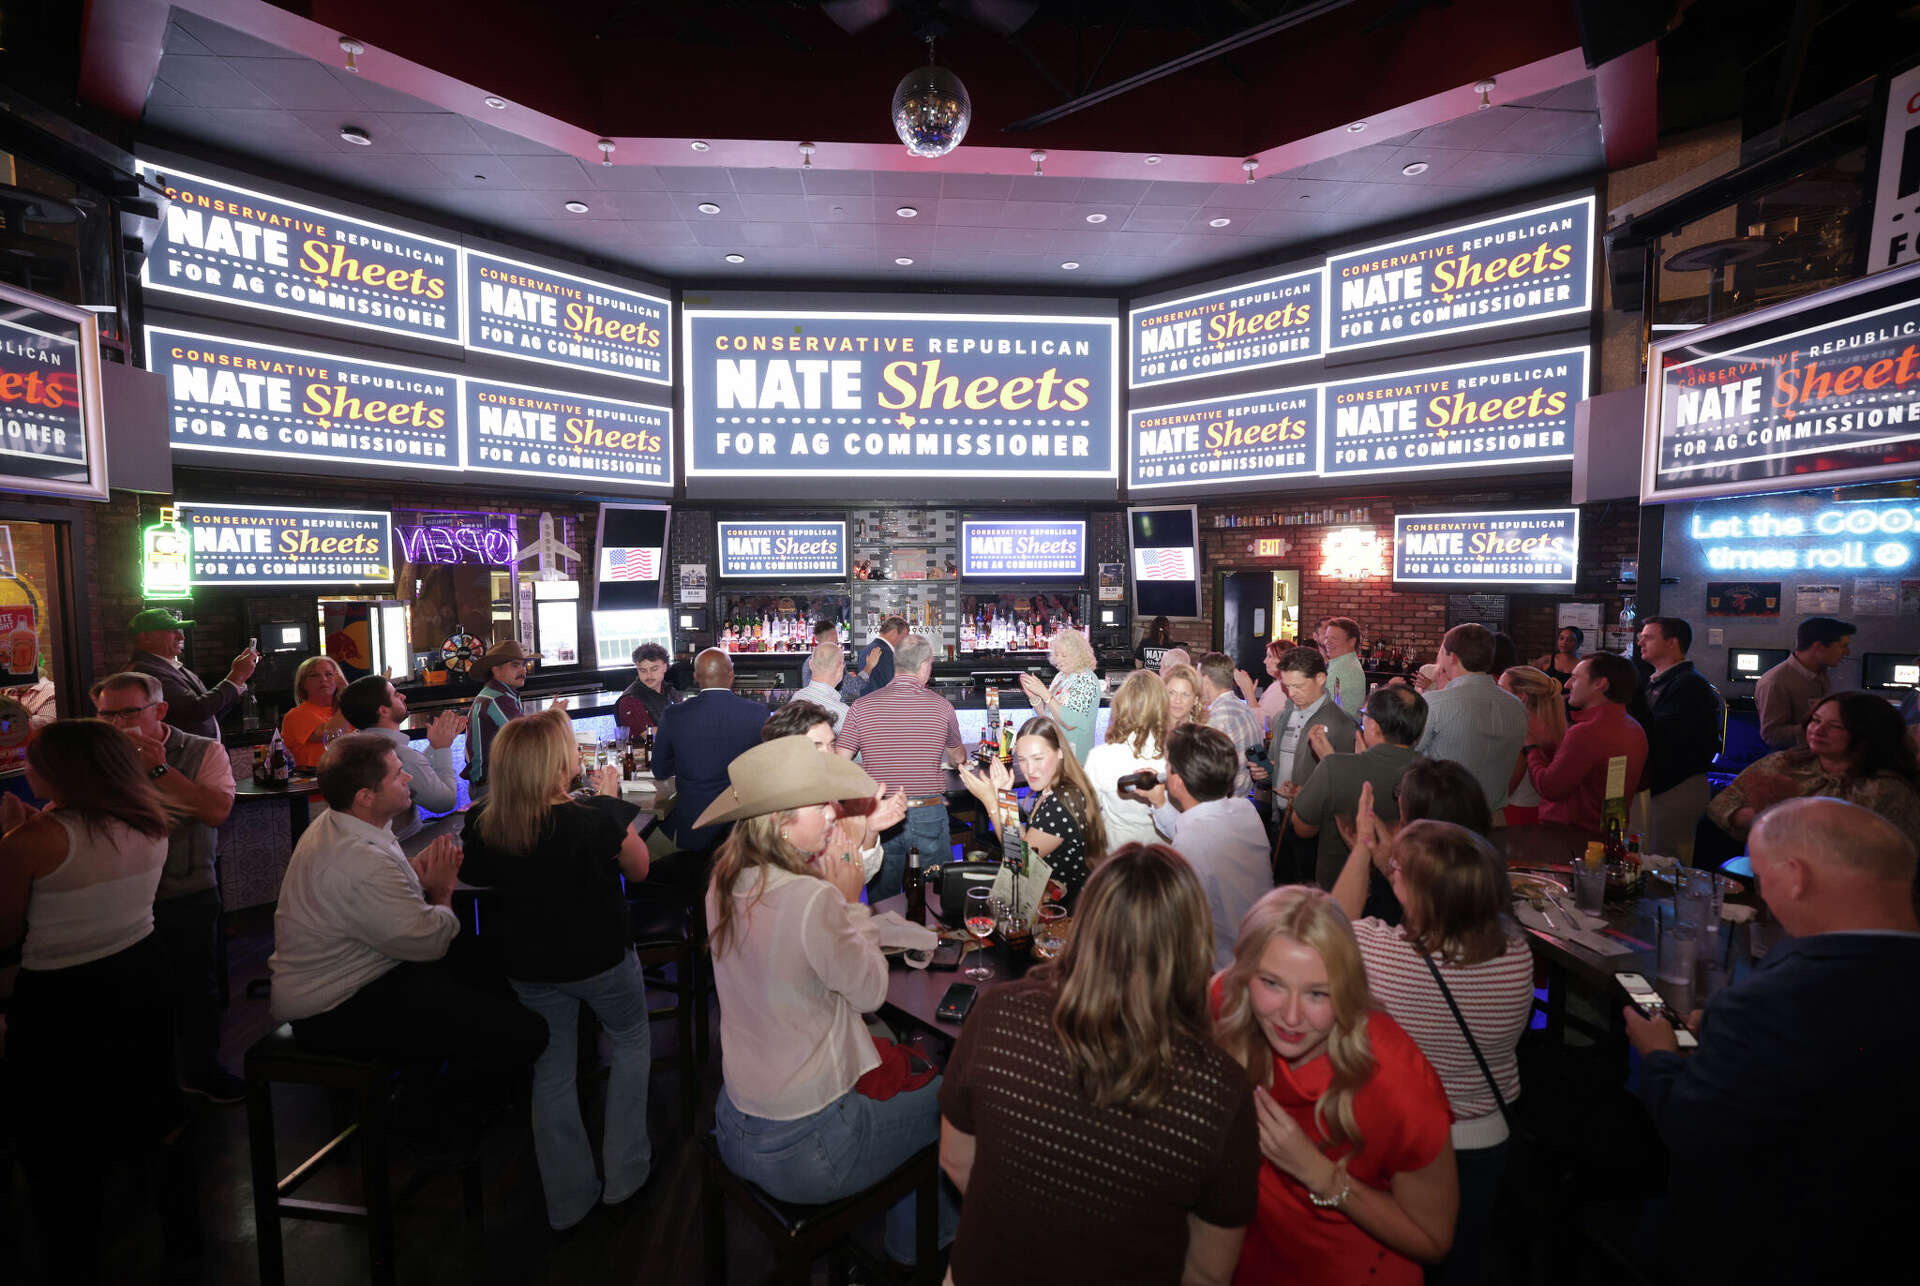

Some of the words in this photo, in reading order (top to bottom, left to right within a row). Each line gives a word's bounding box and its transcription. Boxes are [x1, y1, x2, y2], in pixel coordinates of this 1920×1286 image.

[165, 188, 327, 236] CONSERVATIVE
[337, 230, 444, 266] REPUBLICAN
[168, 205, 288, 267] NATE
[299, 240, 445, 298] Sheets
[1342, 244, 1454, 277] CONSERVATIVE
[1462, 219, 1571, 251] REPUBLICAN
[169, 260, 220, 286] FOR
[232, 272, 263, 294] AG
[275, 281, 445, 328] COMMISSIONER
[480, 267, 582, 299] CONSERVATIVE
[588, 293, 659, 318] REPUBLICAN
[1342, 265, 1422, 311] NATE
[1430, 242, 1571, 293] Sheets
[481, 281, 556, 327] NATE
[564, 303, 660, 347] Sheets
[1142, 302, 1225, 326] CONSERVATIVE
[1231, 284, 1310, 308] REPUBLICAN
[1341, 320, 1372, 338] FOR
[1381, 314, 1402, 331] AG
[1410, 285, 1570, 326] COMMISSIONER
[716, 336, 915, 352] CONSERVATIVE
[929, 338, 1089, 355] REPUBLICAN
[1142, 318, 1201, 355] NATE
[1207, 302, 1310, 341] Sheets
[0, 341, 61, 366] LICAN
[481, 326, 513, 345] FOR
[521, 334, 540, 350] AG
[548, 339, 660, 372] COMMISSIONER
[1141, 362, 1165, 377] FOR
[1171, 358, 1187, 372] AG
[1193, 337, 1309, 368] COMMISSIONER
[1679, 350, 1800, 389] CONSERVATIVE
[1810, 321, 1920, 358] REPUBLIC
[172, 347, 329, 379] CONSERVATIVE
[339, 371, 444, 396] REPUBLICAN
[716, 359, 862, 409] NATE
[877, 359, 1090, 411] Sheets
[1336, 381, 1449, 404] CONSERVATIVE
[1458, 366, 1567, 389] REPUBLICAN
[1676, 376, 1762, 428] NATE
[1771, 344, 1920, 408] Sheet
[173, 364, 291, 412] NATE
[302, 383, 445, 428] Sheets
[478, 393, 581, 414] CONSERVATIVE
[588, 408, 660, 426] REPUBLICAN
[1139, 410, 1222, 428] CONSERVATIVE
[1228, 400, 1306, 417] REPUBLICAN
[1336, 399, 1417, 437] NATE
[1426, 387, 1567, 427] Sheets
[175, 417, 225, 436] FOR
[237, 423, 267, 440] AG
[278, 427, 446, 456] COMMISSIONER
[479, 406, 556, 441] NATE
[563, 418, 661, 452] Sheets
[717, 433, 776, 455] FOR
[791, 433, 829, 455] AG
[844, 433, 1089, 456] COMMISSIONER
[1140, 425, 1198, 456] NATE
[1205, 417, 1306, 448] Sheets
[1336, 448, 1367, 463] FOR
[1376, 445, 1397, 460] AG
[1406, 430, 1565, 458] COMMISSIONER
[1674, 438, 1706, 458] FOR
[1714, 435, 1738, 452] AG
[480, 447, 512, 462] FOR
[520, 450, 540, 464] AG
[547, 453, 661, 475] COMMISSIONER
[1140, 465, 1163, 478] FOR
[1169, 463, 1184, 475] AG
[1191, 452, 1305, 474] COMMISSIONER
[193, 515, 297, 525] CONSERVATIVE
[304, 519, 378, 528] REPUBLICAN
[194, 527, 272, 552] NATE
[279, 529, 378, 553] Sheets
[1405, 522, 1486, 530] CONSERVATIVE
[1692, 514, 1743, 539] Let
[1749, 512, 1803, 537] the
[1816, 508, 1920, 535] GOO
[728, 538, 770, 554] NATE
[775, 537, 837, 554] Sheets
[971, 537, 1012, 553] NATE
[1016, 536, 1076, 553] Sheets
[1259, 539, 1280, 555] EXIT
[1405, 533, 1463, 554] NATE
[1469, 531, 1564, 553] Sheets
[1708, 546, 1797, 570] times
[1807, 541, 1867, 569] roll
[196, 563, 228, 574] FOR
[236, 564, 256, 574] AG
[263, 564, 379, 574] COMMISSIONER
[729, 562, 746, 570] FOR
[766, 562, 838, 570] COMMISSIONER
[1405, 564, 1428, 573] FOR
[1434, 564, 1449, 573] AG
[1455, 564, 1563, 574] COMMISSIONER
